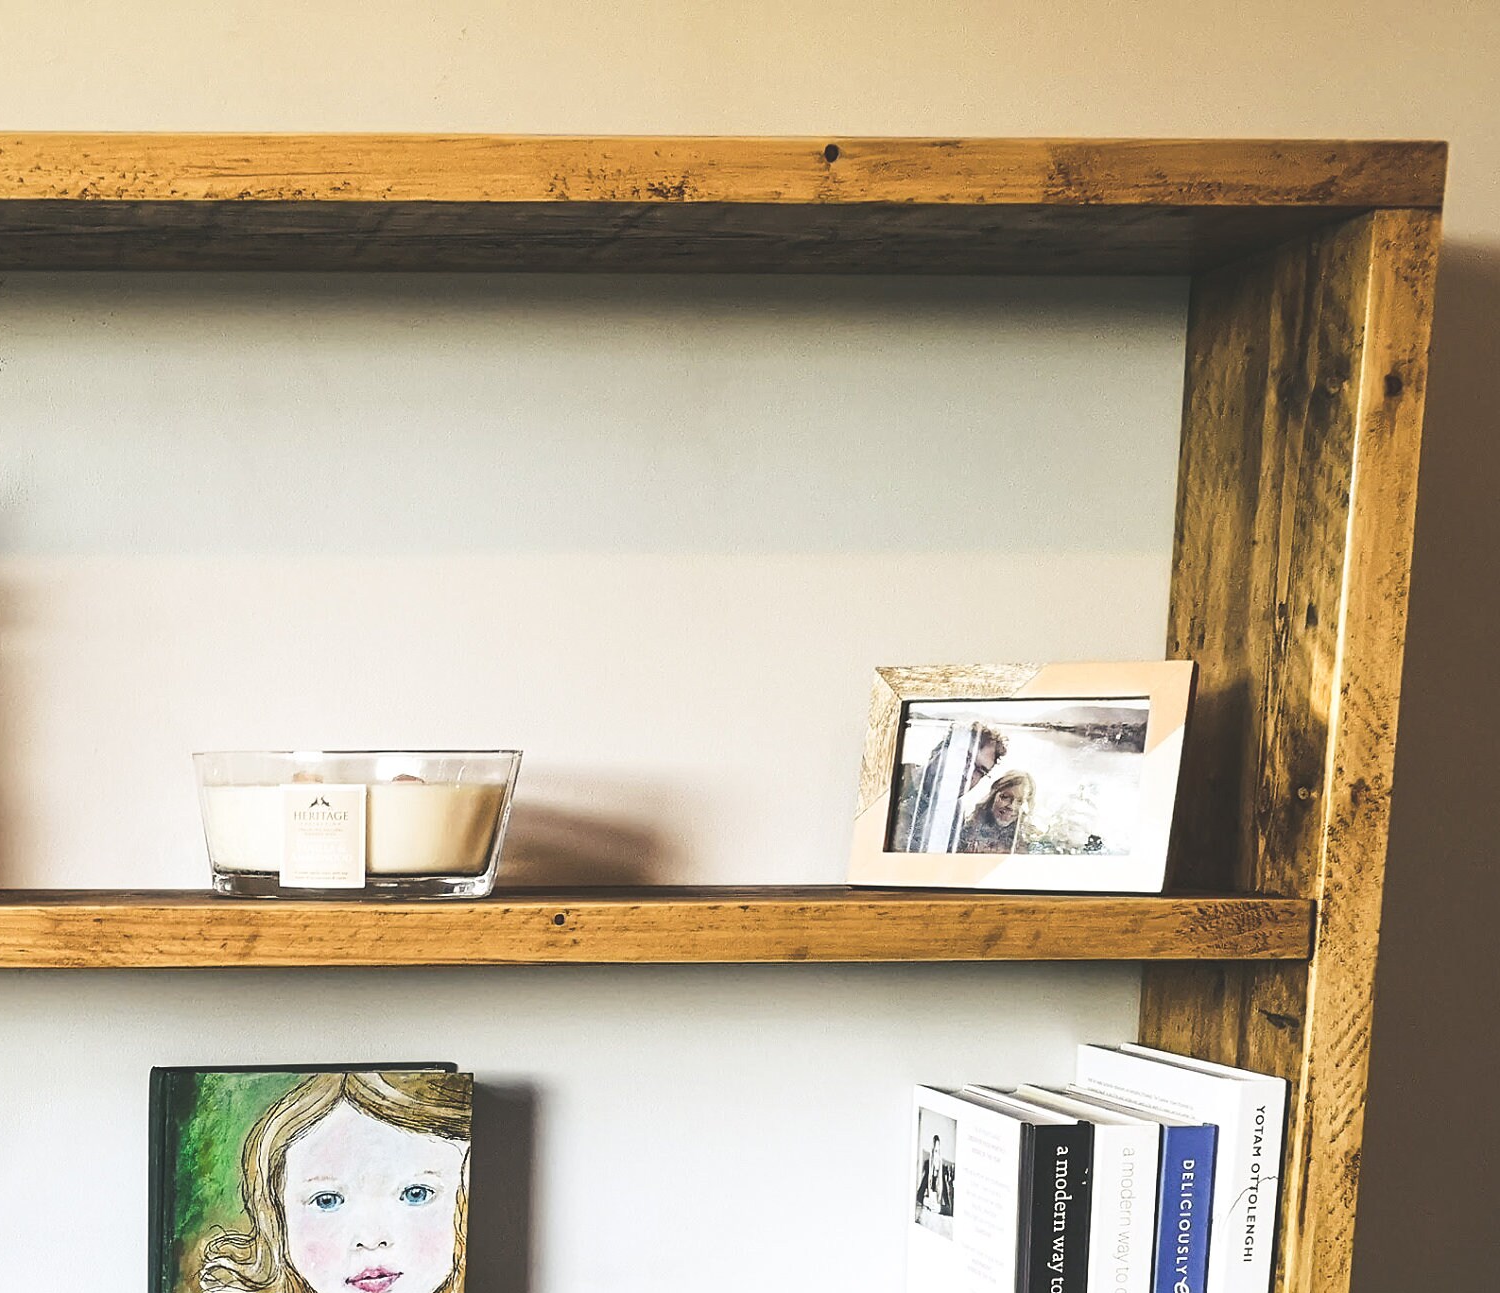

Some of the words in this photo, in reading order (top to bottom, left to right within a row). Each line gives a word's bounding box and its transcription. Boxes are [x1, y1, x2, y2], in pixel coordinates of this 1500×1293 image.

[293, 810, 349, 821] HERITAGE
[1251, 1105, 1266, 1157] YOTAM
[1056, 1145, 1069, 1156] a
[1122, 1147, 1135, 1157] a
[1053, 1159, 1073, 1232] modern
[1119, 1162, 1137, 1227] modern
[1243, 1162, 1261, 1263] OTTOLENGHI
[1173, 1159, 1195, 1276] DELICIOUSLY
[1046, 1235, 1066, 1273] way
[1112, 1231, 1130, 1263] way
[1115, 1266, 1129, 1284] to
